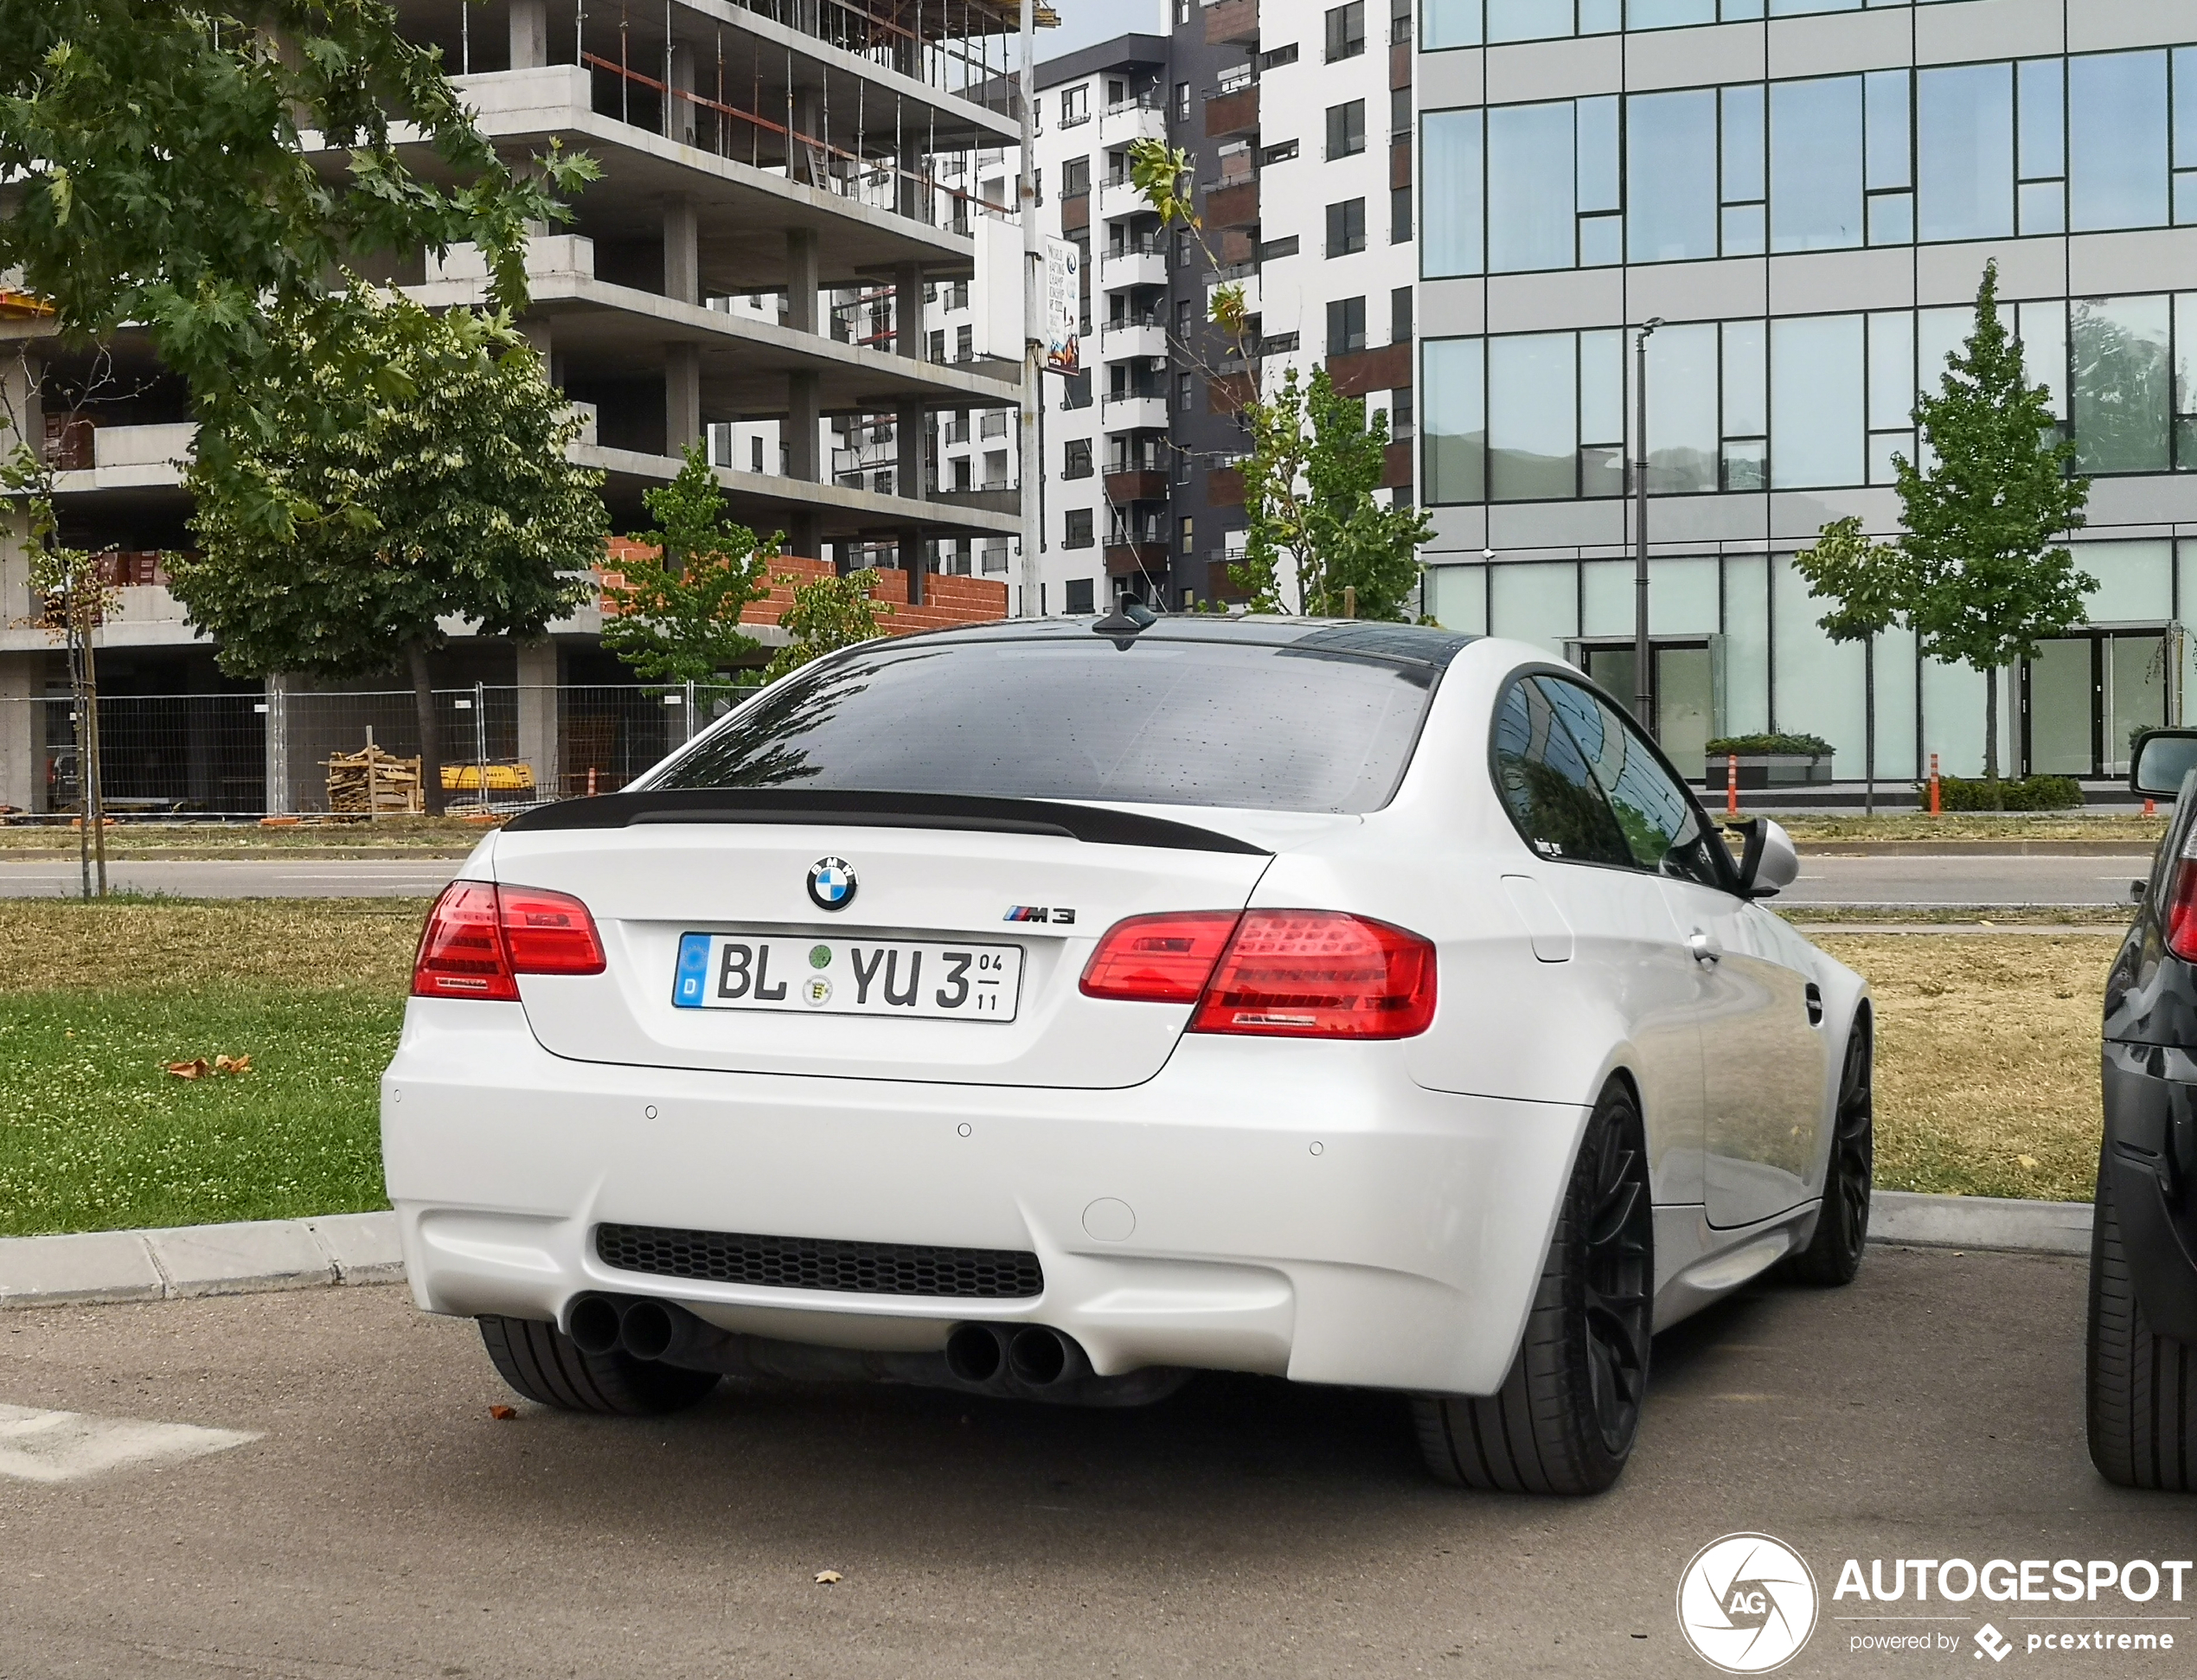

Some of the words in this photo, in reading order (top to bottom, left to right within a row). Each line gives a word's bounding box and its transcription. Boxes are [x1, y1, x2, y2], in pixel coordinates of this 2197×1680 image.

[1047, 244, 1062, 261] WORLD
[810, 857, 855, 877] BMW
[979, 954, 1002, 971] 04
[683, 978, 696, 994] D
[717, 944, 787, 1001] BL
[851, 948, 922, 1007] YU
[936, 952, 972, 1008] 3
[978, 994, 996, 1010] 11
